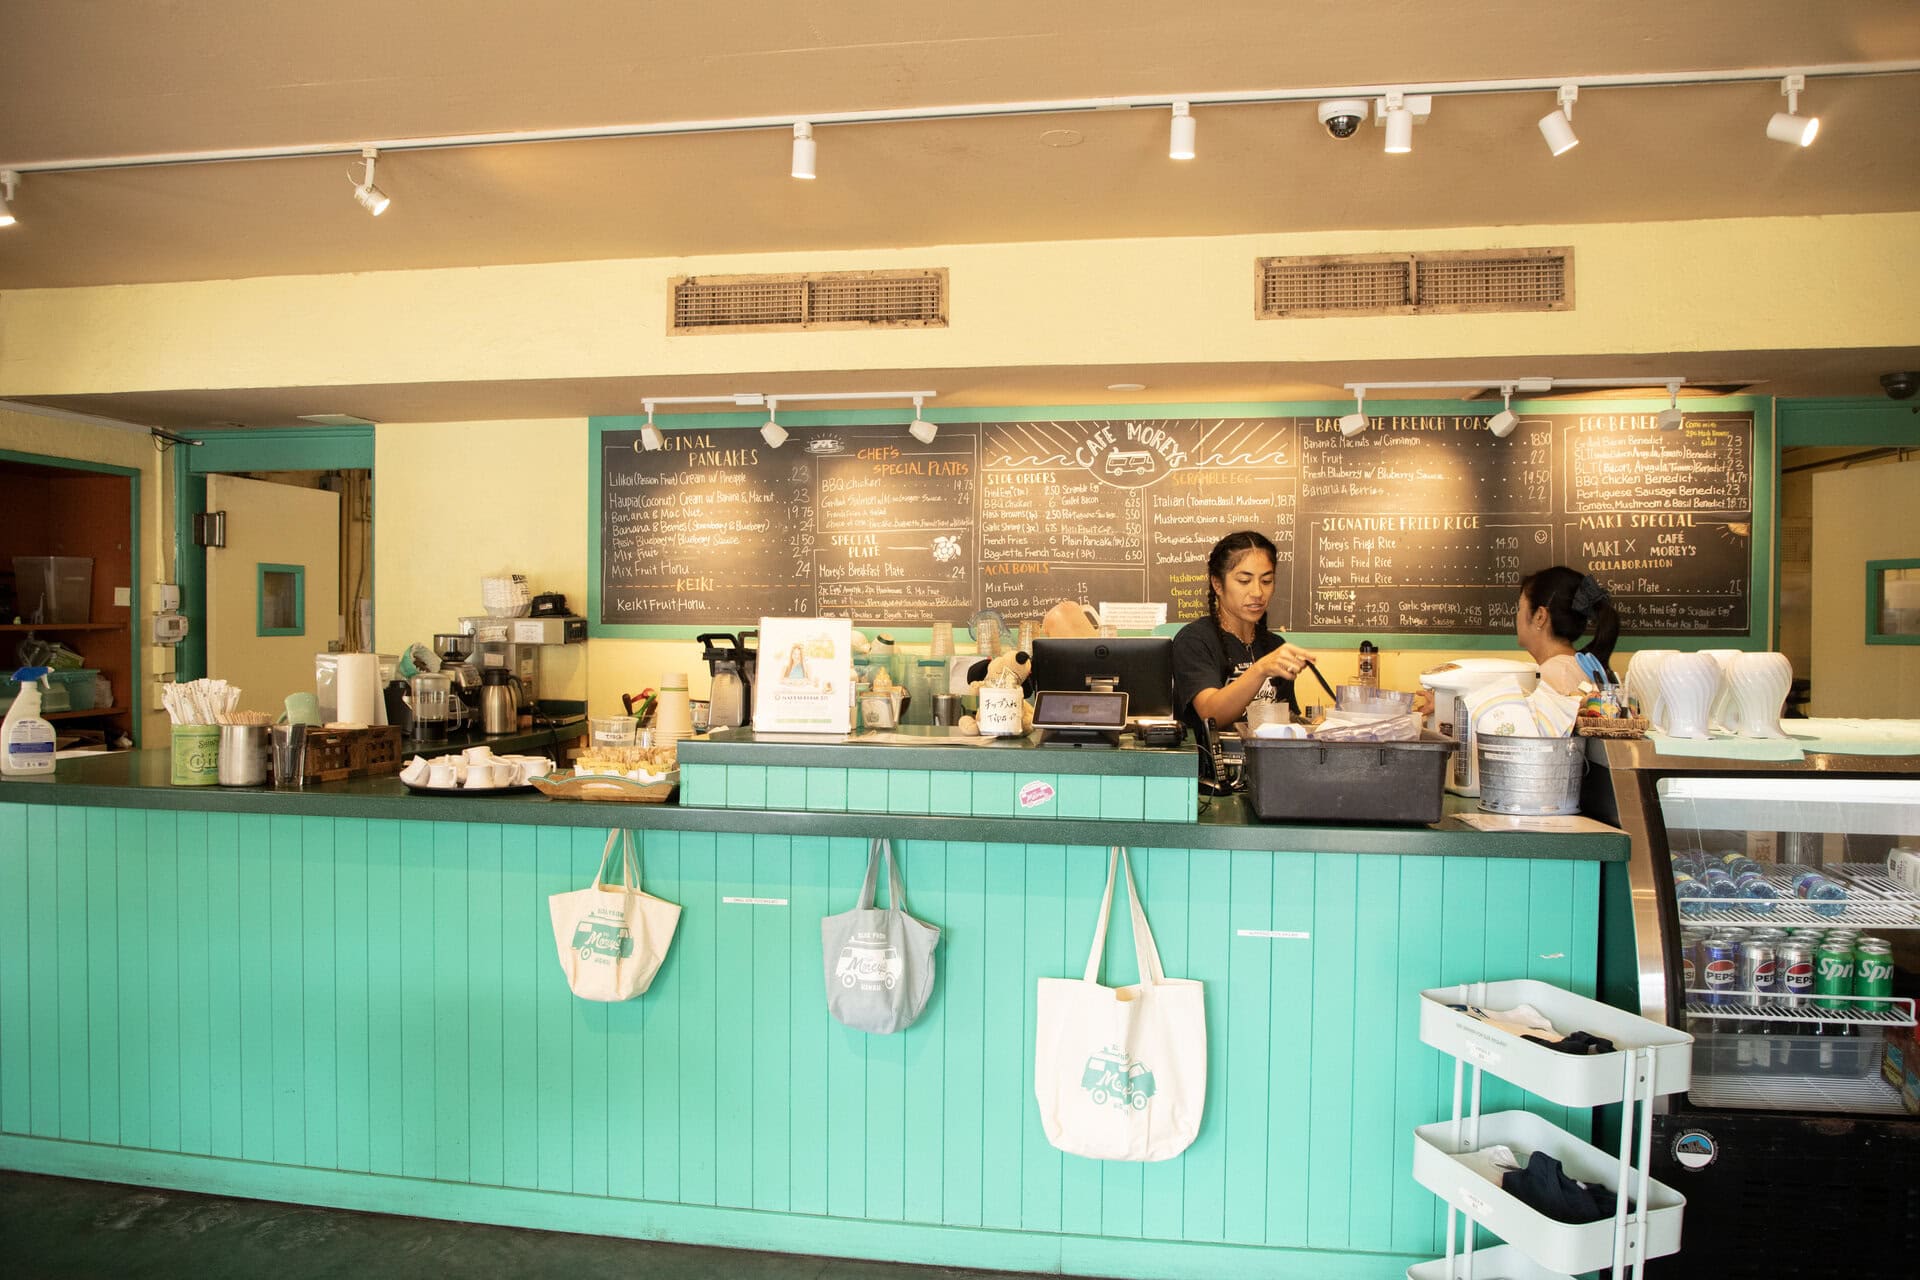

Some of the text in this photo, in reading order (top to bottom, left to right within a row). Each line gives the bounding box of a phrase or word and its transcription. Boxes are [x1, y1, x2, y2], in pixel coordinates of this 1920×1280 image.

[1392, 415, 1447, 431] FRENCH
[1451, 416, 1490, 431] TOAS
[1608, 415, 1686, 432] BENEDT
[633, 433, 717, 454] OGINAL
[1075, 424, 1117, 468] CAFE
[1303, 434, 1421, 450] Banana w/ Cinnamon
[1627, 434, 1664, 446] Benedict
[1727, 434, 1743, 448] 23
[689, 448, 759, 468] PANCAKES
[1302, 449, 1545, 465] Mix Fruit 22
[1686, 447, 1743, 460] Benedict 23
[873, 460, 970, 477] SPECIAL PLATES
[1303, 465, 1326, 479] Fresh
[1695, 460, 1726, 473] Benedict
[1727, 459, 1745, 472] 23
[680, 471, 706, 486] Cream
[791, 465, 811, 483] 23
[987, 471, 1057, 485] SIDE ORDERS
[1172, 471, 1228, 486] SCRAMBLE
[1575, 475, 1599, 488] BBQ
[1644, 472, 1693, 485] Benedict
[821, 478, 845, 493] BBQ
[1129, 488, 1137, 498] 6
[1302, 483, 1547, 500] Banana Berries 22
[1576, 483, 1741, 501] Portuguese Sausage Benedict 23
[680, 488, 811, 506] Cream 23
[957, 492, 970, 505] 24
[1153, 493, 1185, 508] Italian
[1614, 498, 1662, 510] Mushroom
[1672, 498, 1692, 508] Basil
[1693, 497, 1726, 509] Benedict
[612, 508, 681, 524] Banana Mac
[1196, 512, 1260, 525] Onion Spinach
[1321, 515, 1481, 532] SIGNATURE FRIED RICE
[1579, 513, 1698, 531] MAKI SPECIAL
[612, 518, 815, 537] Banana 24
[831, 534, 877, 546] SPECIAL
[983, 533, 1057, 545] French Fries 6
[1154, 531, 1194, 546] Portuguese
[1319, 536, 1350, 552] Morey's
[1353, 536, 1375, 550] Fried
[1377, 536, 1398, 550] Rice
[1656, 530, 1686, 545] CAFÉ
[614, 545, 812, 563] Mix Fruit 24
[848, 545, 881, 559] PLATE
[983, 546, 1075, 560] Baguette French Toast
[1582, 540, 1697, 558] MAKI MOREY'S
[1156, 551, 1184, 564] Smoked
[1319, 554, 1393, 568] Kimchi Fried Rice
[1588, 558, 1674, 572] COLLABORATION
[611, 560, 812, 579] Mix Fruit Honu 24
[848, 562, 881, 577] Breakfast
[884, 561, 905, 578] Plate
[951, 565, 967, 580] 24
[1012, 560, 1049, 575] BOWLS
[676, 576, 715, 593] KEIKI
[1318, 573, 1342, 586] Vegan
[1350, 573, 1370, 585] Fried
[1374, 573, 1393, 585] Rice
[1607, 576, 1742, 597] Special Plate 25
[985, 582, 1088, 593] Mix Fruit 15
[1170, 587, 1204, 597] Choice of
[985, 596, 1019, 608] Banana
[1316, 589, 1350, 602] TOPPINGS
[649, 599, 676, 612] Fruit
[678, 598, 706, 612] Honu
[794, 598, 808, 613] 16
[1399, 600, 1511, 616] Garlic BBQ
[1178, 610, 1200, 620] French
[1705, 971, 1735, 981] PEPS
[1786, 974, 1813, 984] PEPS
